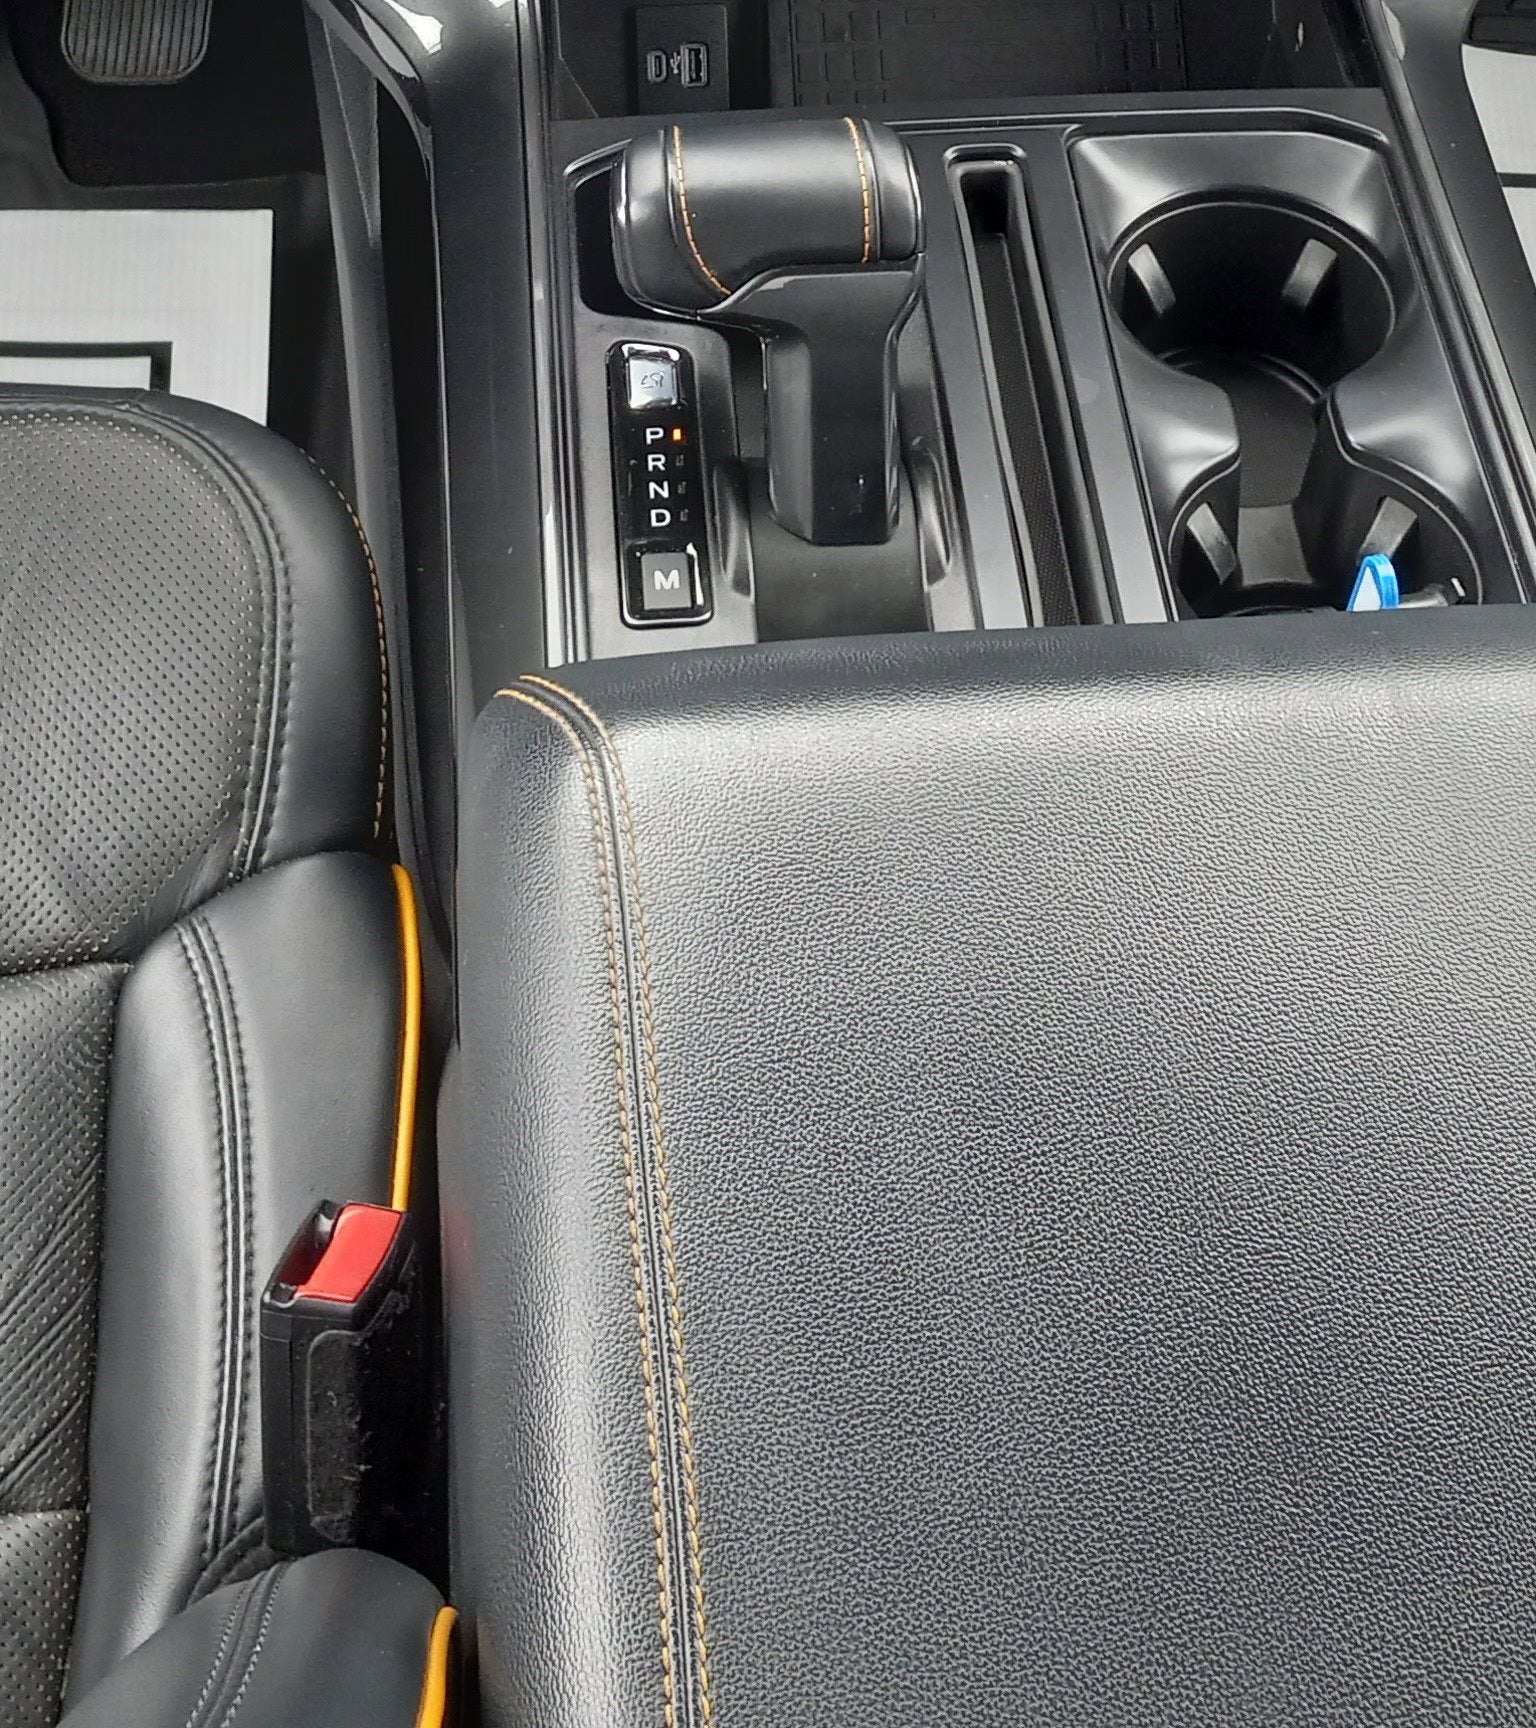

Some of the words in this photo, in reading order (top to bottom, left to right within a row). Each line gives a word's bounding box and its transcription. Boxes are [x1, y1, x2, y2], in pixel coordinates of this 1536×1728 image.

[645, 428, 664, 445] P
[647, 454, 666, 472] R
[649, 481, 670, 499] N
[650, 508, 671, 527] D
[654, 570, 681, 591] M
